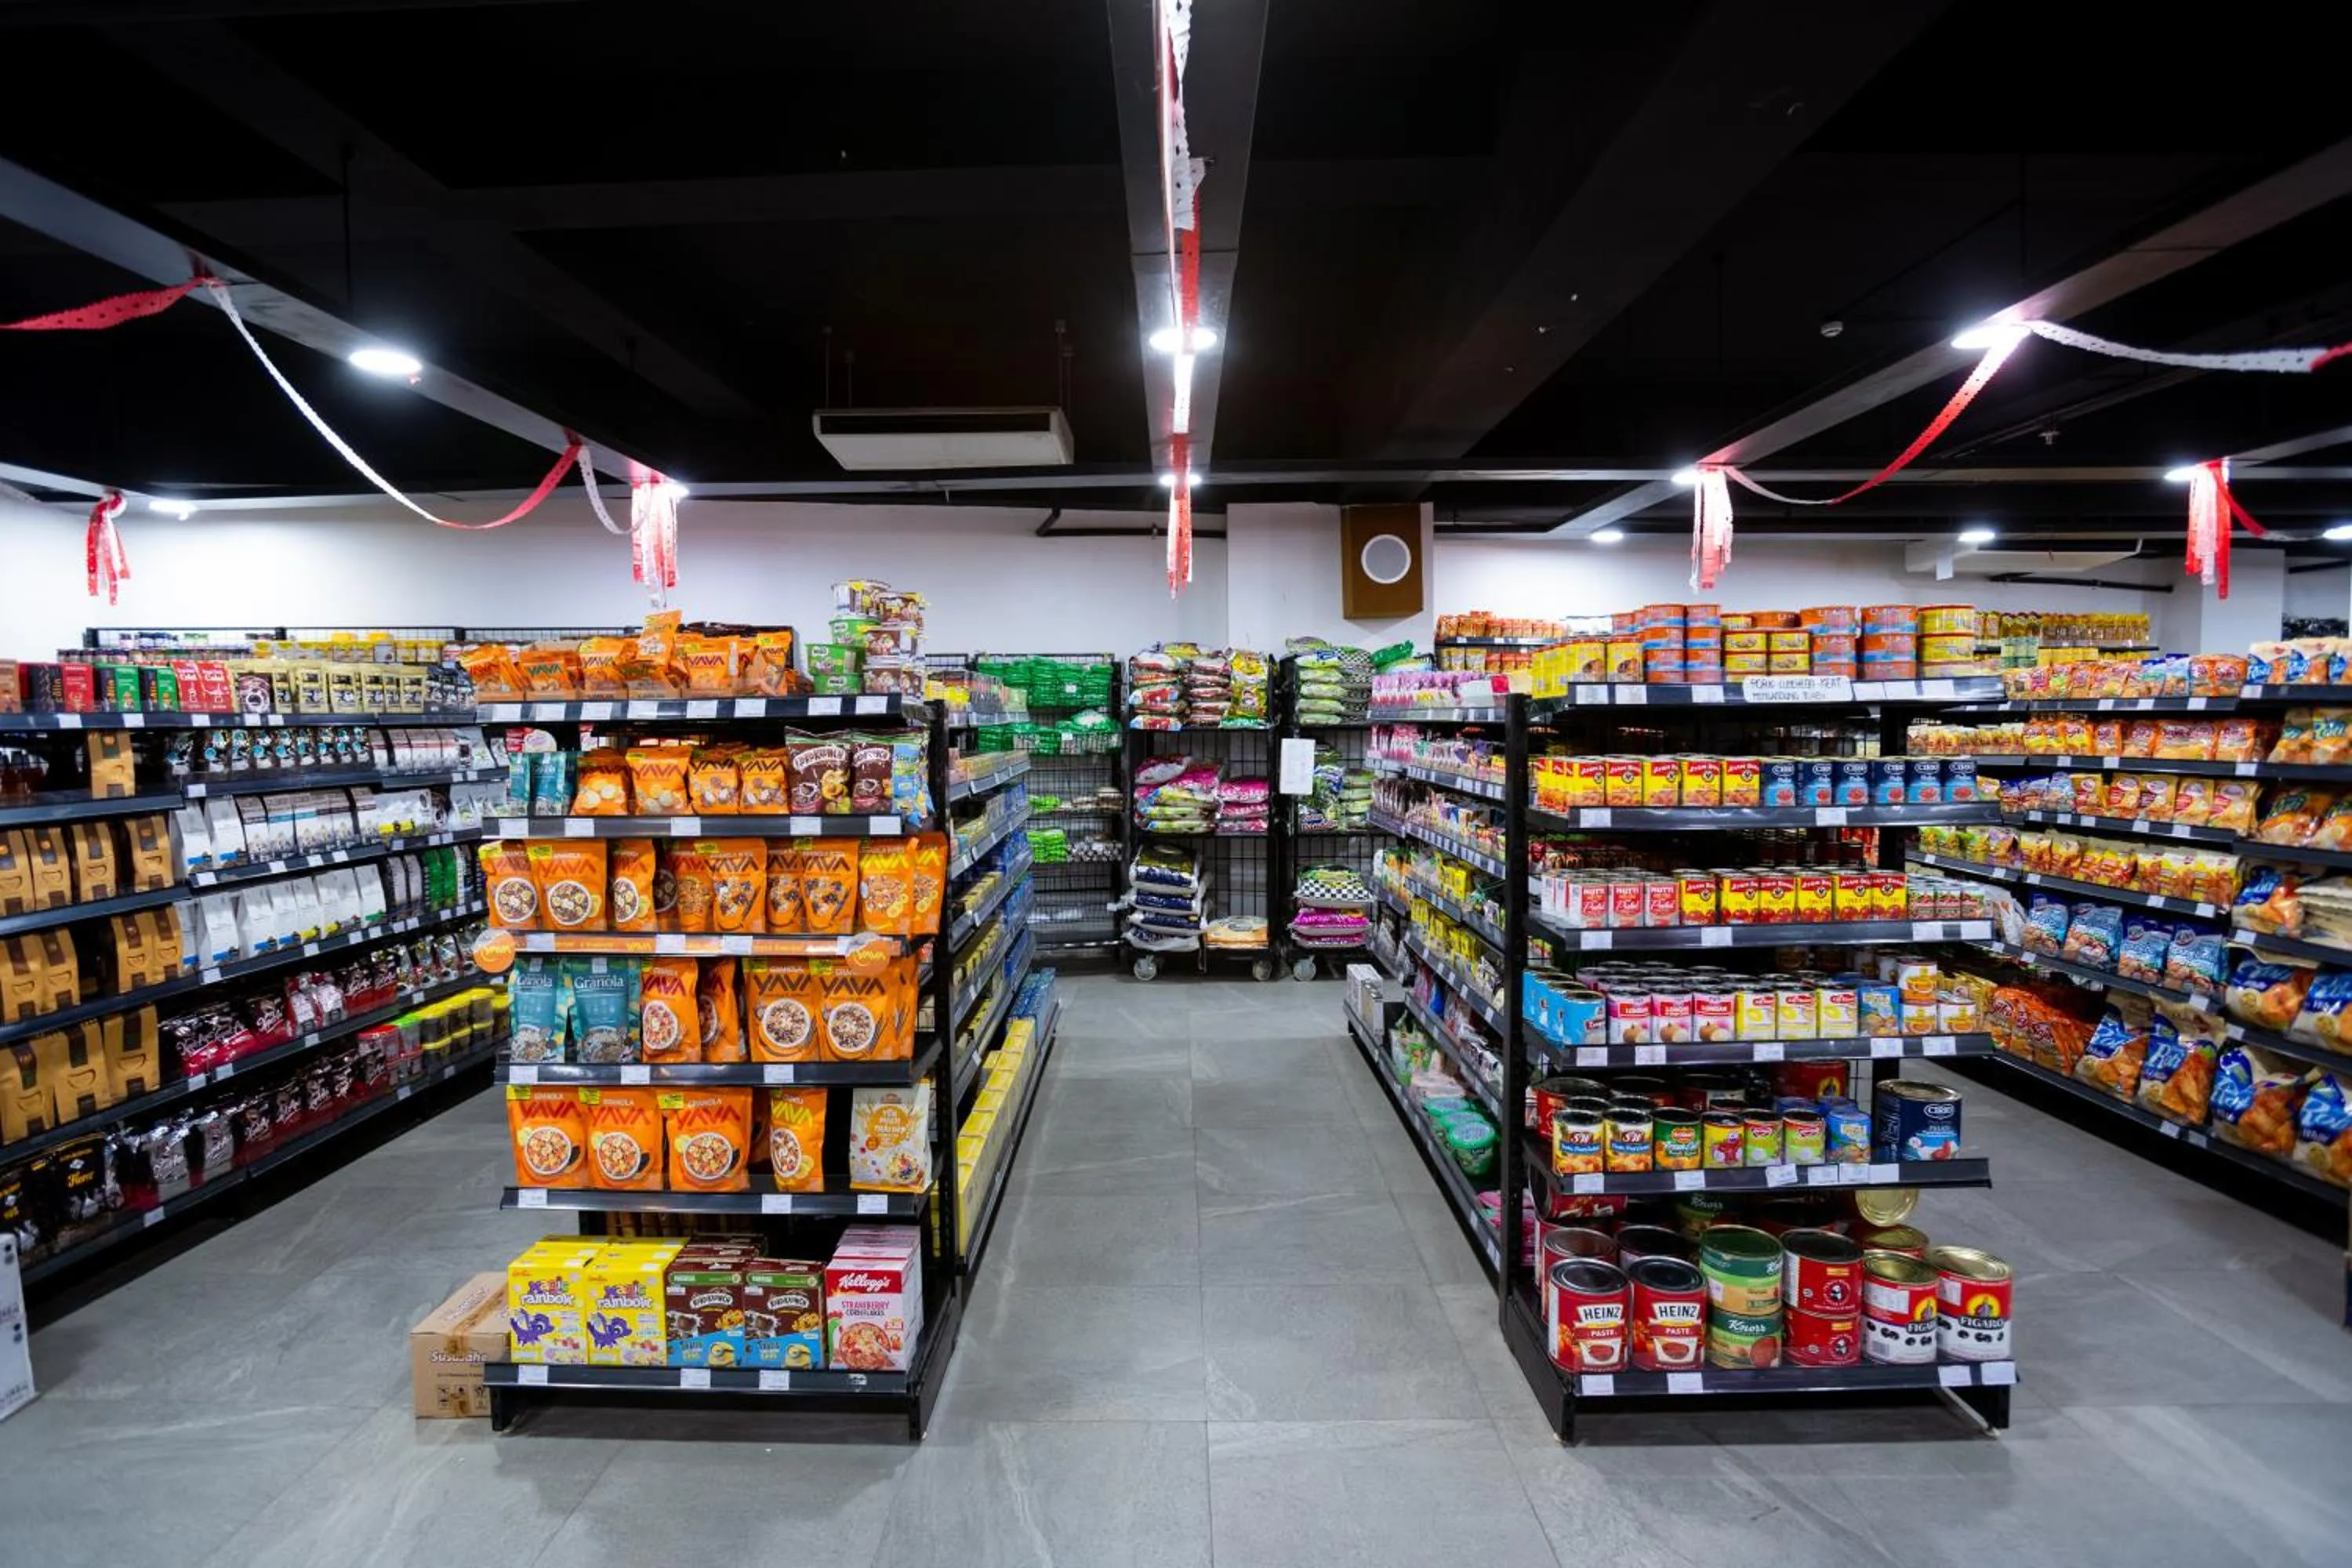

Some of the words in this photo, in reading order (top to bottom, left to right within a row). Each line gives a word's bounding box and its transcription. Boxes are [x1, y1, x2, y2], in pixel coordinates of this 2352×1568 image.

[574, 975, 624, 989] Granola
[839, 1272, 891, 1292] Kellogg's
[1583, 1305, 1621, 1320] HEINZ
[1658, 1304, 1697, 1319] HEINZ
[1728, 1319, 1766, 1333] Knorr
[1590, 1329, 1615, 1338] PASTE
